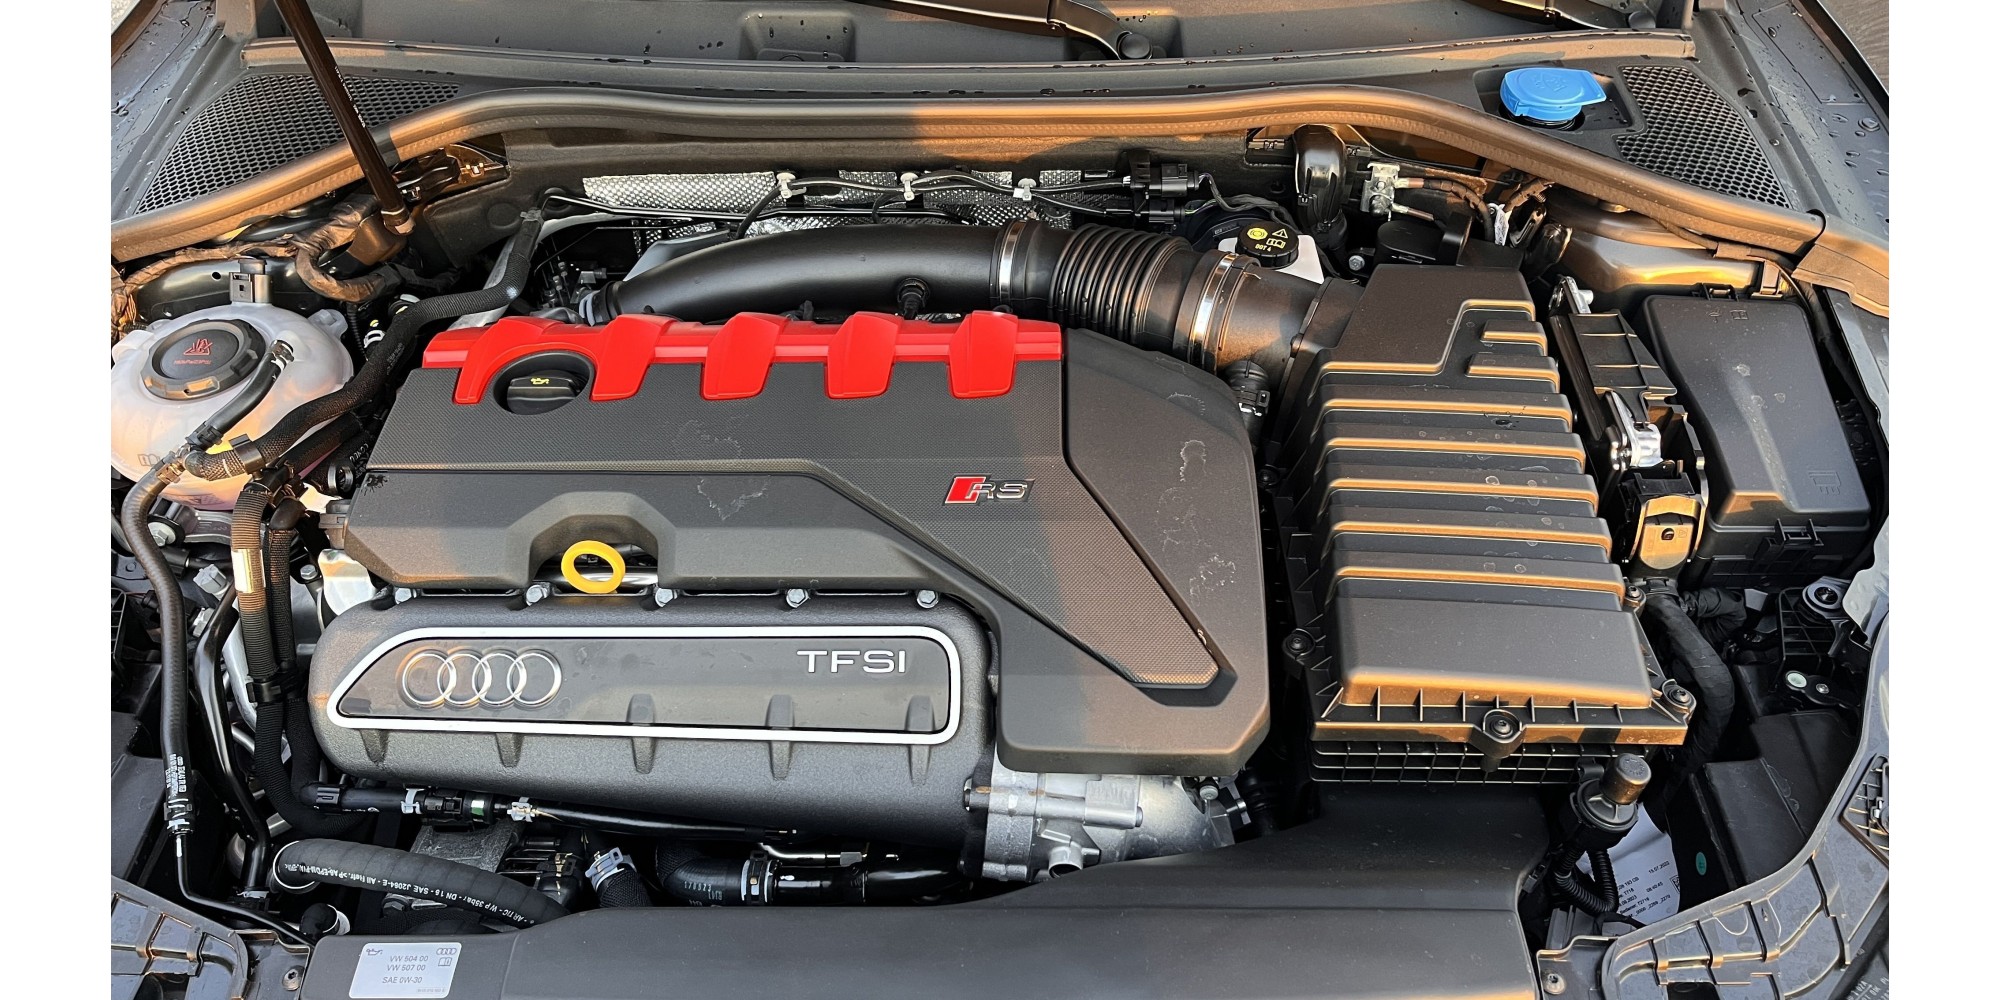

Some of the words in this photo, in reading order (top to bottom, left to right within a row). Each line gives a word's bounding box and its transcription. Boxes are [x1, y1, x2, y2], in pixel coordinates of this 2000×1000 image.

[962, 481, 1028, 500] RS
[797, 650, 906, 673] TFSI
[413, 885, 430, 894] SAE
[445, 892, 457, 900] DN
[382, 976, 398, 984] SAE
[399, 976, 423, 984] 0W-30
